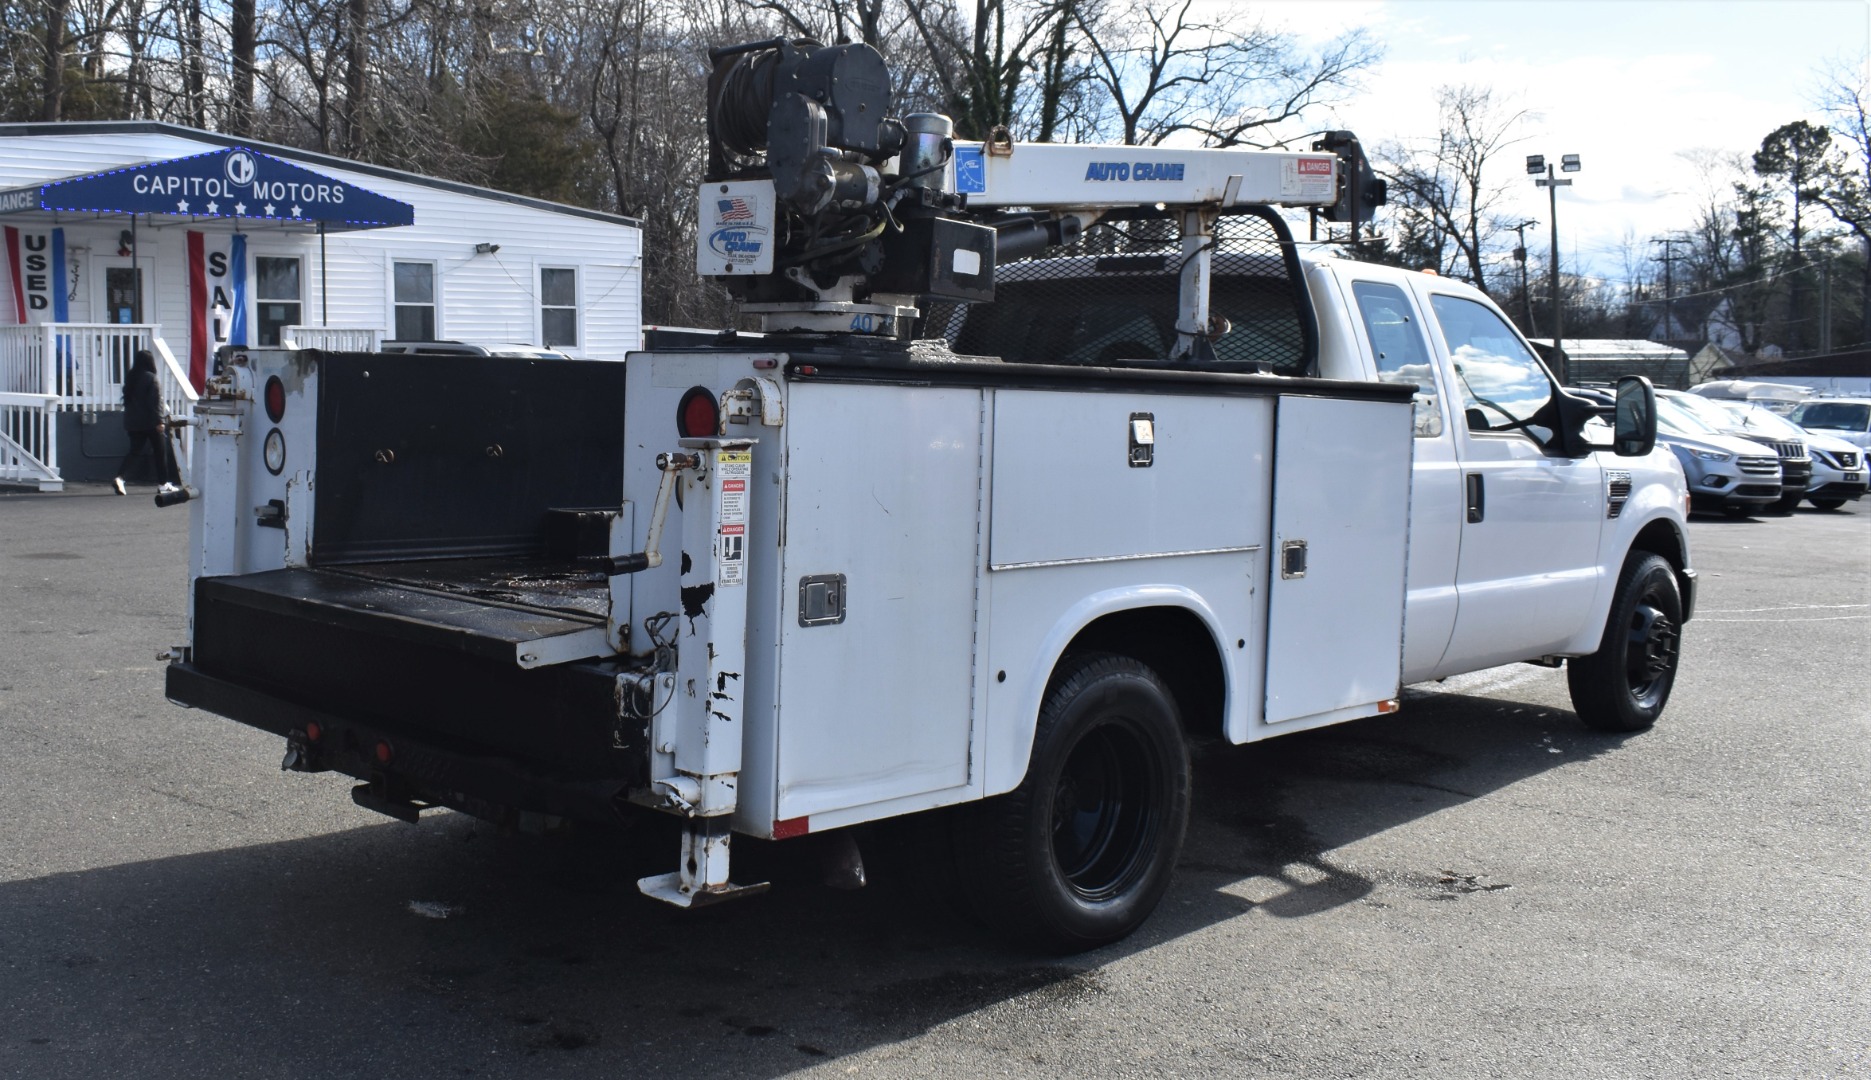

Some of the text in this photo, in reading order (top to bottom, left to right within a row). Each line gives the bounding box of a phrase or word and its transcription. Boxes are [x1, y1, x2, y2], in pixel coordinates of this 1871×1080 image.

[1085, 162, 1185, 181] AUTO CRANE
[1306, 162, 1330, 171] DANGER
[133, 174, 344, 204] CAPITOL MOTORS
[0, 191, 33, 210] ANCE
[718, 230, 747, 241] AUTO
[725, 241, 762, 252] CRANE
[25, 235, 48, 310] USED
[850, 313, 872, 333] 40
